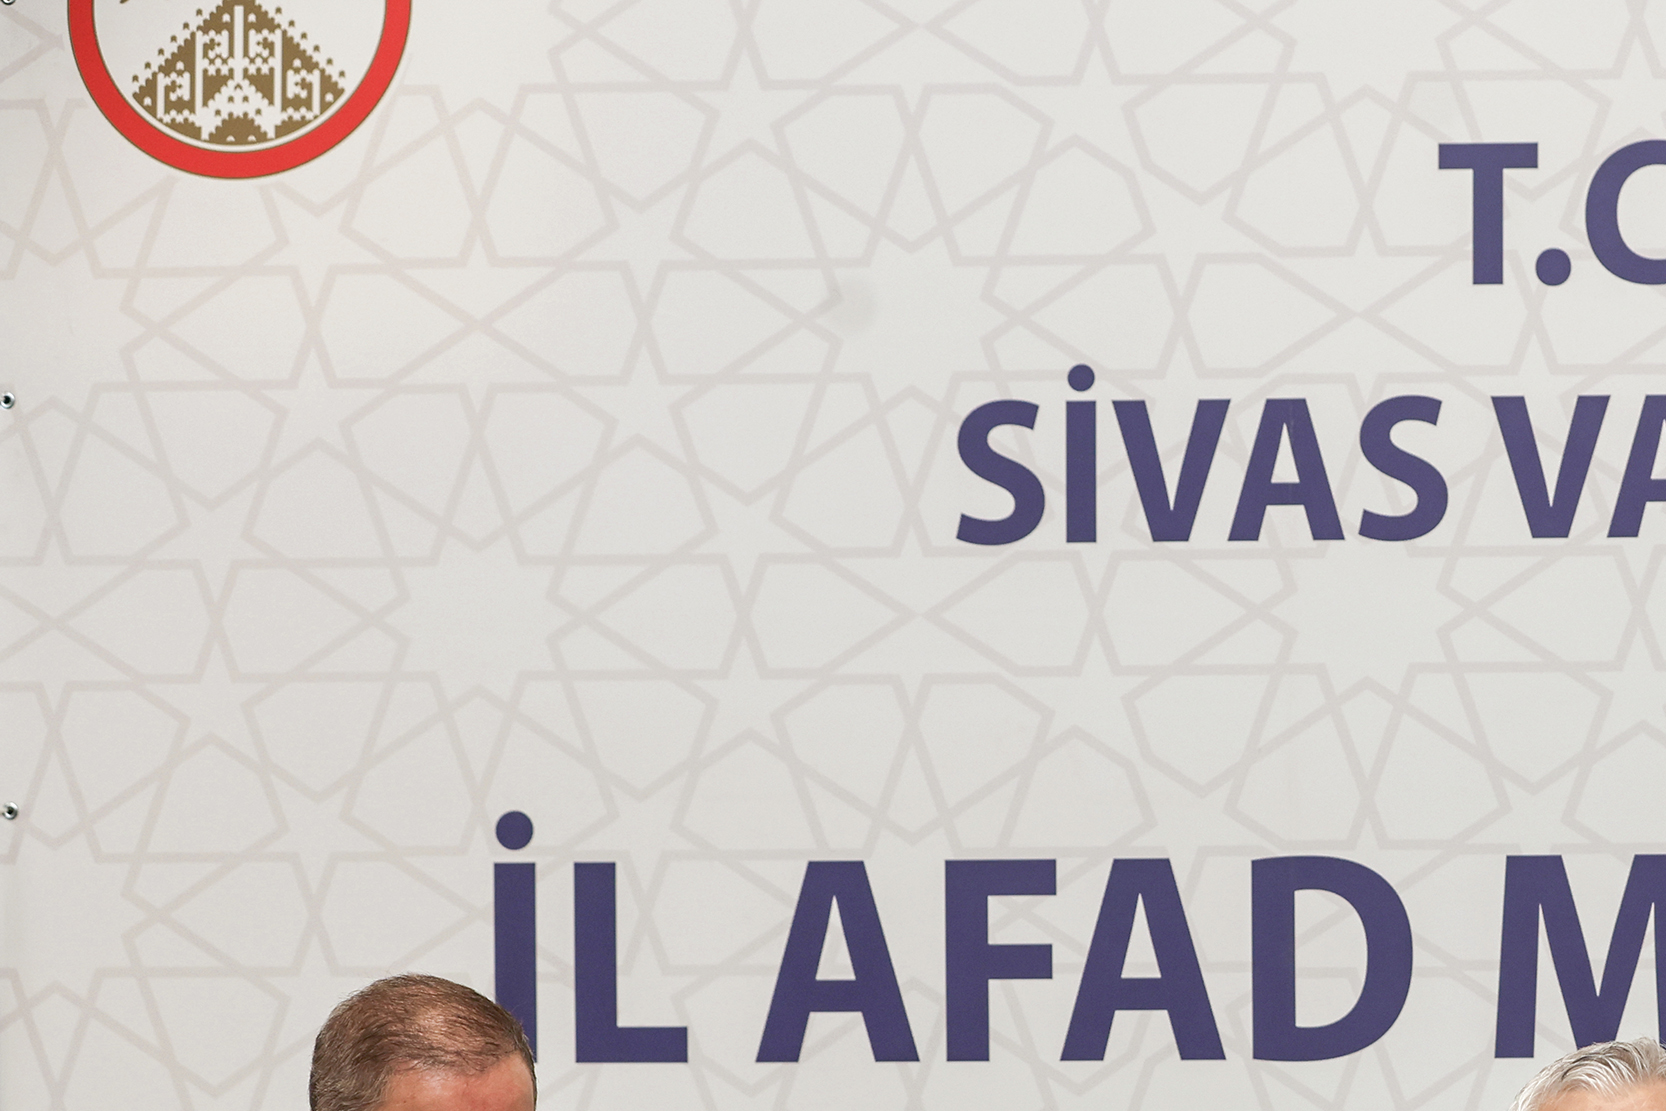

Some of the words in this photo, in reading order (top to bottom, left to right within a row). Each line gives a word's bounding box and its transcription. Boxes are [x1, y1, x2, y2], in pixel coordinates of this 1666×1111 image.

[955, 363, 1449, 546] SİVAS
[493, 810, 689, 1064] İL
[755, 856, 1414, 1064] AFAD
